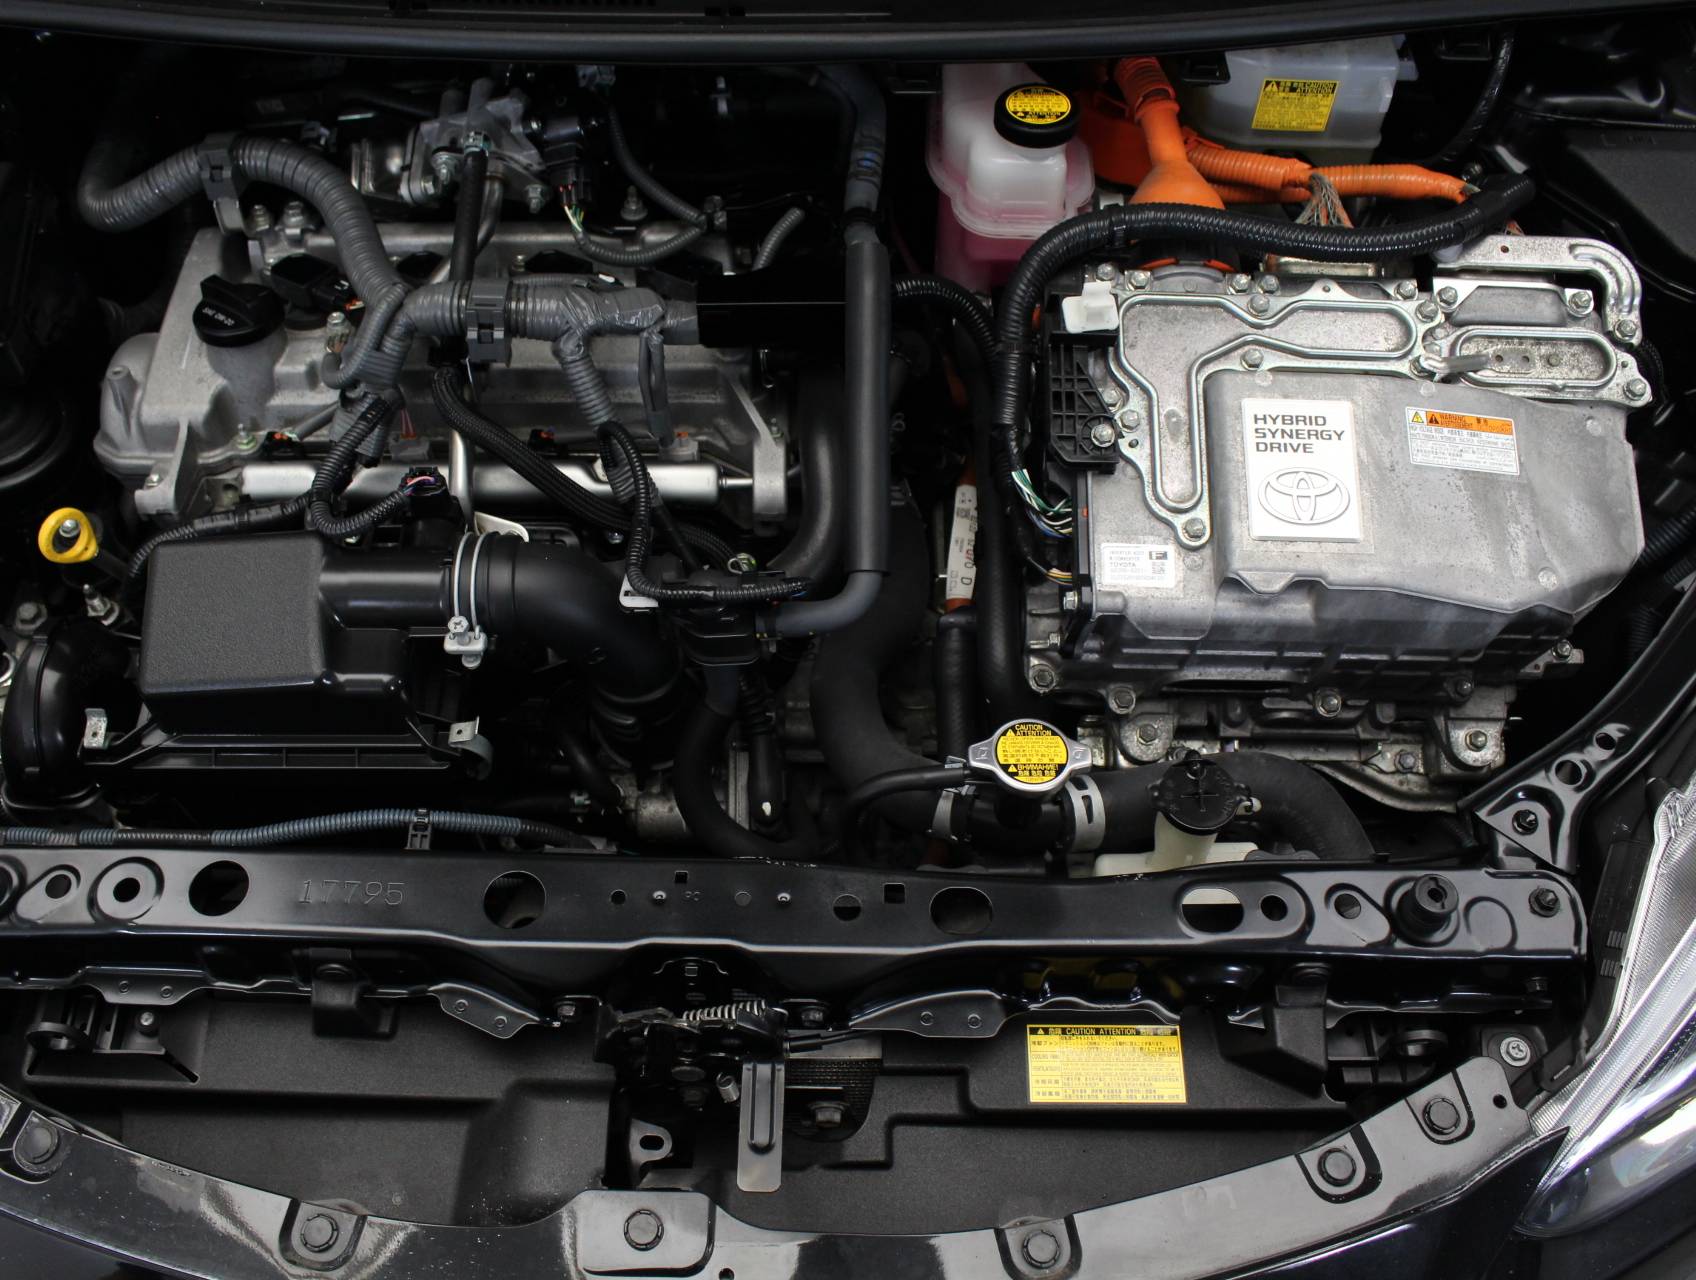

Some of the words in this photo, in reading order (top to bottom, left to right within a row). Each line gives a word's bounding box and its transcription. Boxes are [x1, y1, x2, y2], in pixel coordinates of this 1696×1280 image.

[1253, 414, 1327, 427] HYBRID
[1254, 427, 1345, 441] SYNERGY
[1255, 441, 1315, 454] DRIVE
[297, 879, 406, 906] 17795
[1066, 1027, 1096, 1035] CAUTION
[1099, 1027, 1137, 1035] ATTENTION
